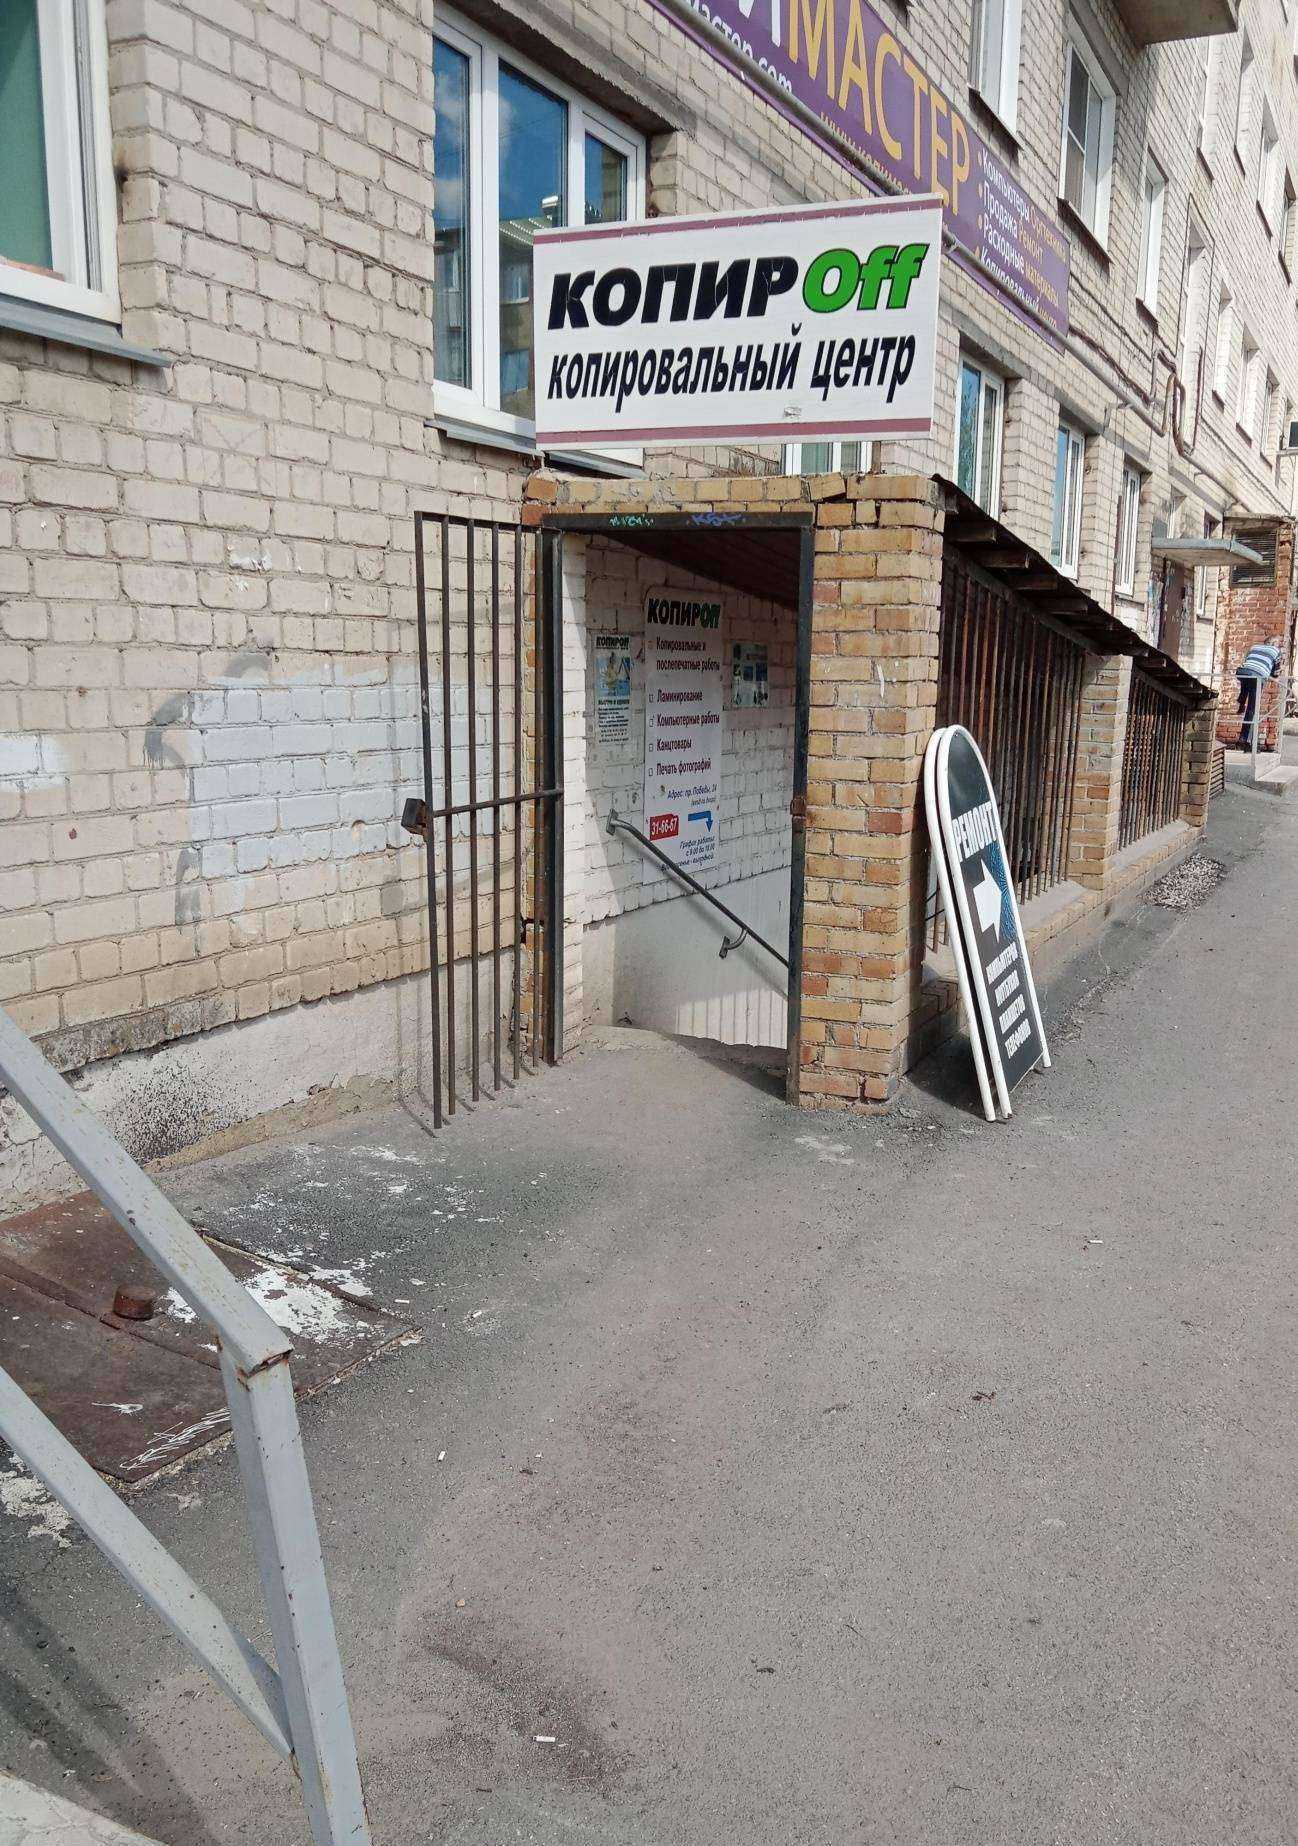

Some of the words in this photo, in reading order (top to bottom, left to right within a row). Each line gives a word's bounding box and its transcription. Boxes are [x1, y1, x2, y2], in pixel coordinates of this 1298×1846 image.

[983, 148, 1030, 225] Компьютеры
[984, 180, 1018, 239] Продажа
[1018, 220, 1044, 264] Ремонт
[983, 212, 1025, 275] Расходные
[547, 322, 802, 413] копировальный
[810, 335, 916, 403] центр
[656, 637, 703, 652] Копировальные
[656, 659, 701, 671] послепечатные
[701, 658, 720, 672] работы
[657, 688, 703, 704] Ламинирование
[656, 713, 700, 727] Компьютерные
[701, 710, 720, 726] работы
[656, 738, 692, 752] Канцтовары
[656, 762, 677, 776] Печать
[678, 758, 712, 775] фотографий
[952, 801, 997, 862] РЕМОНТ
